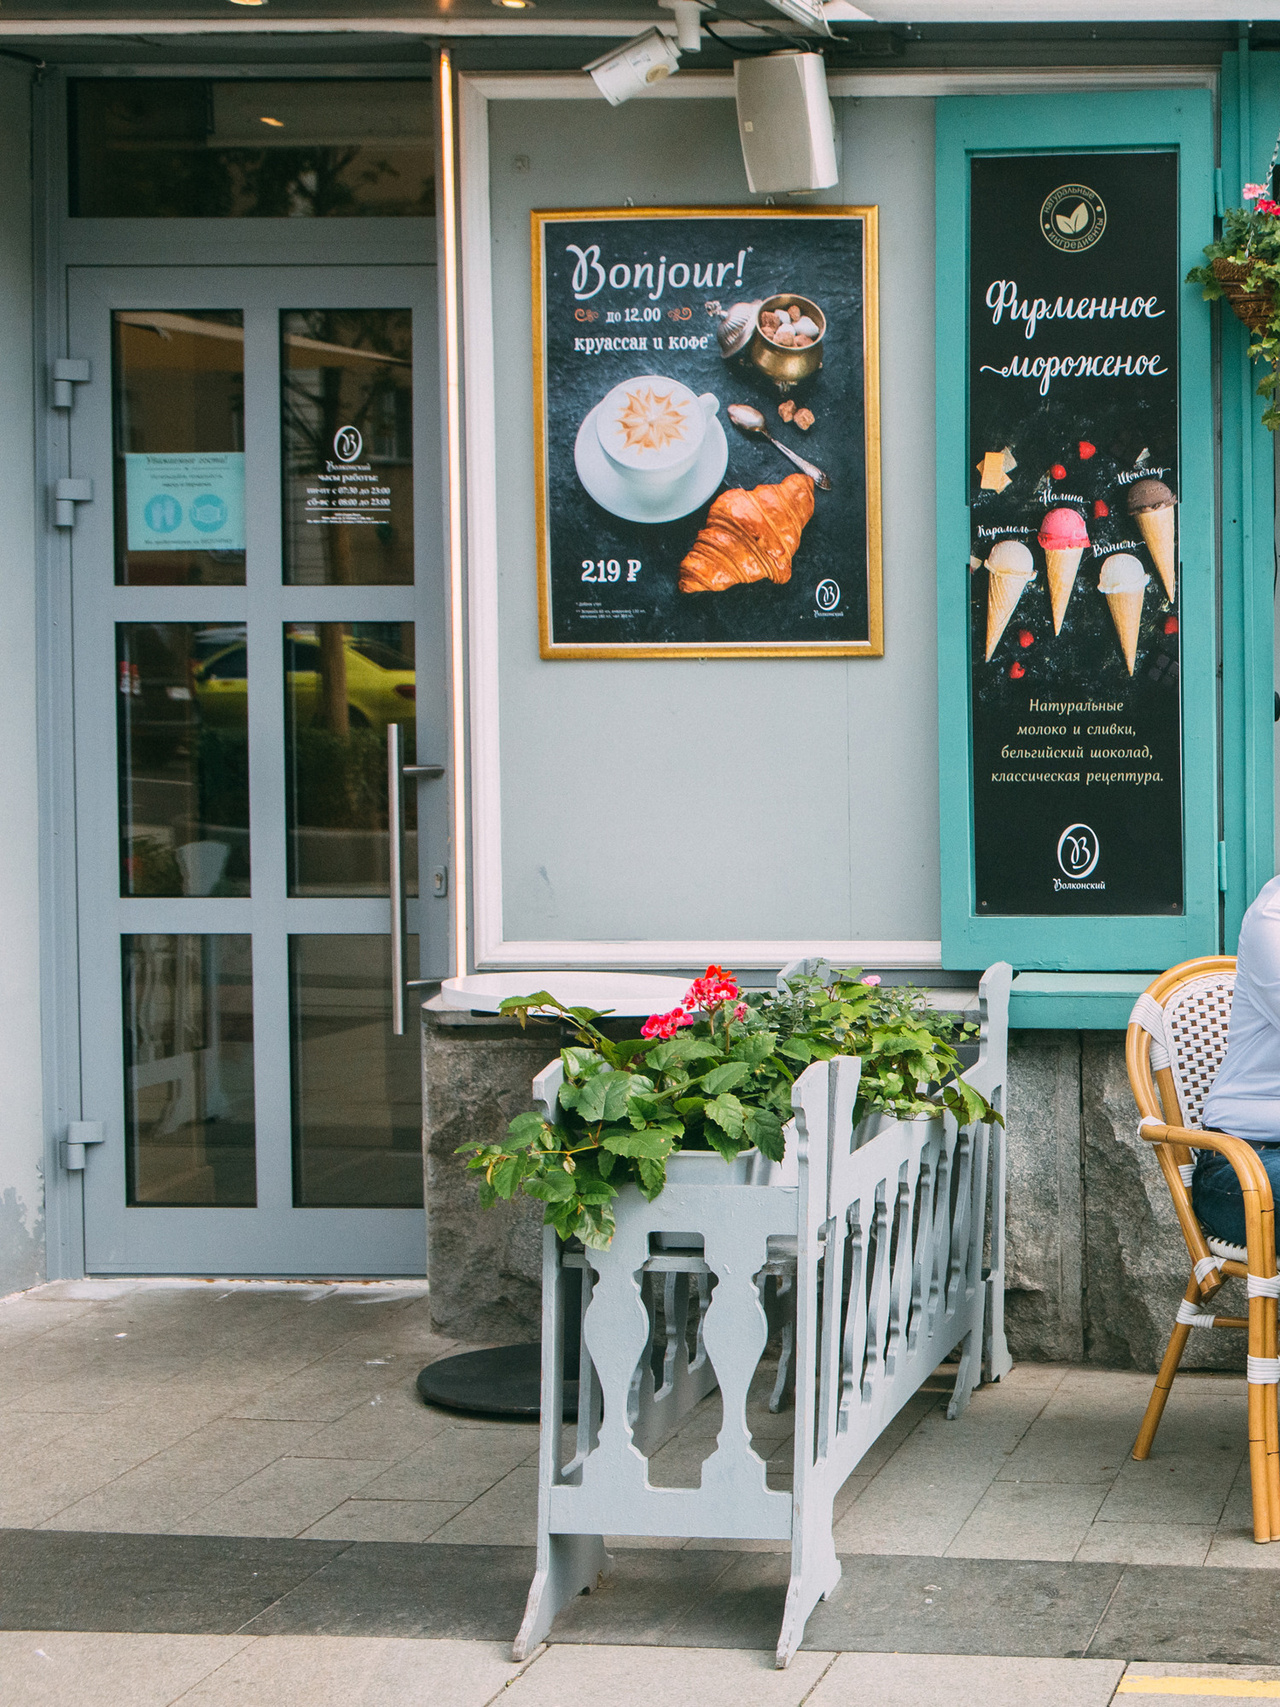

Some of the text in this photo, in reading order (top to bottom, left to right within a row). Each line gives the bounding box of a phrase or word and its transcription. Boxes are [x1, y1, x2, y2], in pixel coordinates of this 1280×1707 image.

[1043, 187, 1095, 214] натуральные
[1048, 217, 1104, 250] ингредиенты
[605, 308, 662, 324] до 12.00
[985, 279, 1166, 340] Фирменное
[574, 336, 648, 355] круассан
[652, 336, 663, 350] и
[980, 354, 1168, 396] мороженое
[1117, 466, 1171, 485] Шоколад
[1039, 489, 1091, 506] Малина
[977, 525, 1037, 538] Карамель
[1092, 539, 1145, 558] Ваниль
[581, 559, 621, 583] 219
[1029, 699, 1124, 715] Натуральные
[1017, 723, 1136, 737] молоко и сливки,
[1001, 744, 1153, 760] бельгийский шоколад,
[991, 771, 1164, 785] классическая рецептура.
[1053, 878, 1106, 891] Волконский
